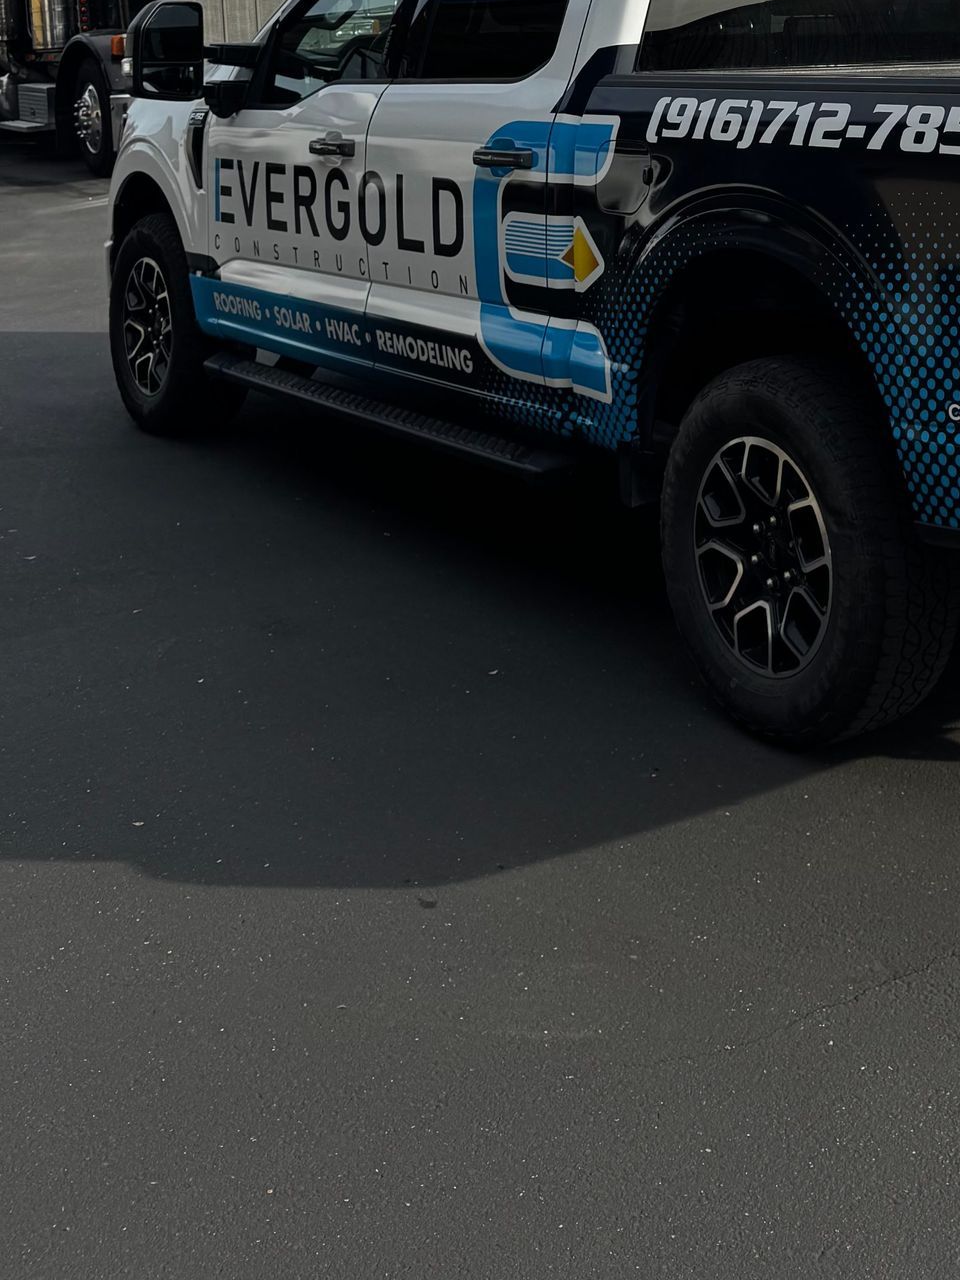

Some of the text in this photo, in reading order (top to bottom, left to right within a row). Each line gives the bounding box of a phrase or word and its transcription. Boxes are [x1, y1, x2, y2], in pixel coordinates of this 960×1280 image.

[214, 157, 464, 258] EVERGOLD
[213, 233, 469, 296] CONSTRUCTION
[212, 291, 474, 375] ROOFING SOLAR HVAC REMODELING
